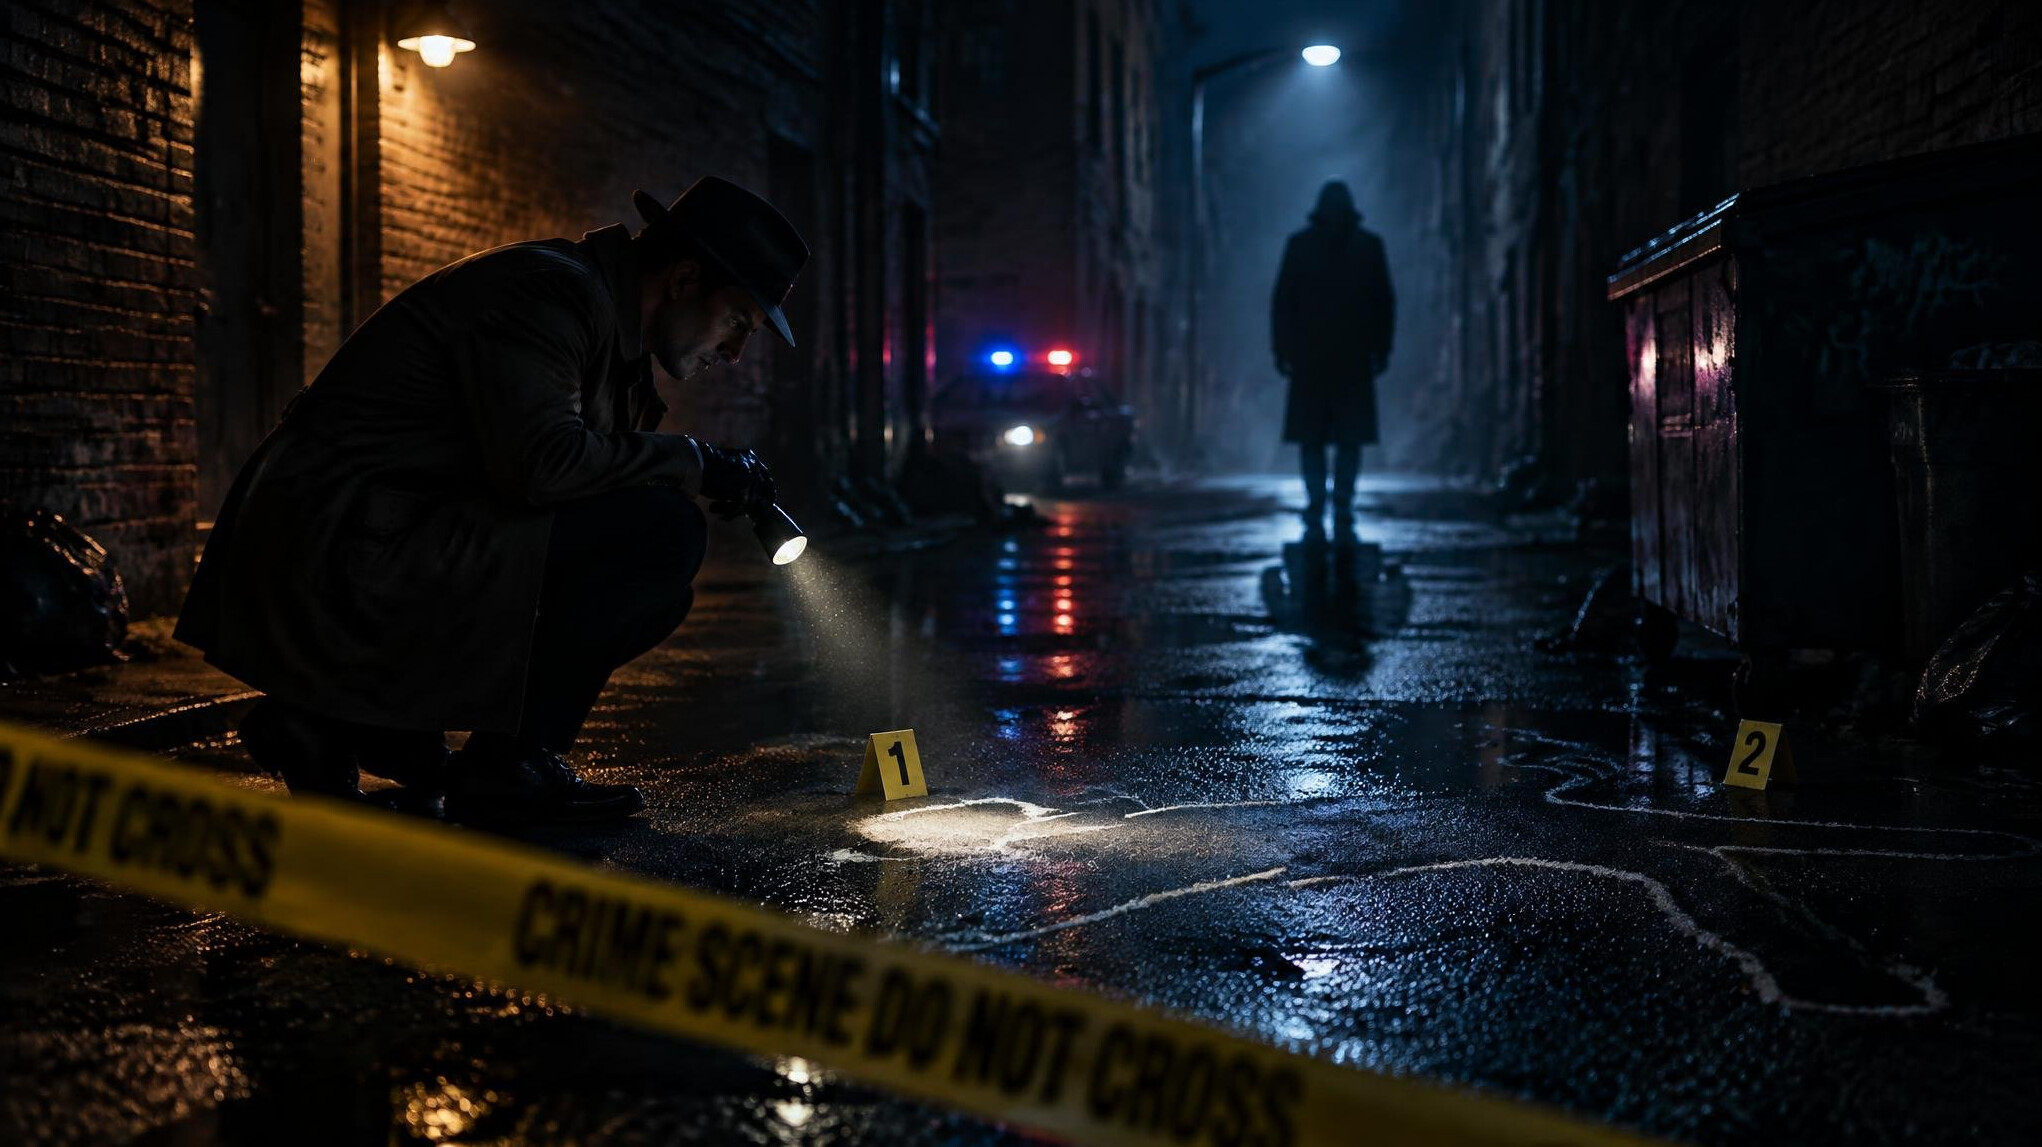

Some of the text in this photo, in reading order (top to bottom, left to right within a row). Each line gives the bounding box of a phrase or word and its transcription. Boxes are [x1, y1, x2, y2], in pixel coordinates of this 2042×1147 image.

[888, 741, 909, 785] 1
[1738, 731, 1766, 775] 2
[10, 760, 110, 853] NOT
[112, 783, 280, 896] CROSS
[516, 881, 1304, 1147] CRIME SCENE DO NOT CROSS
